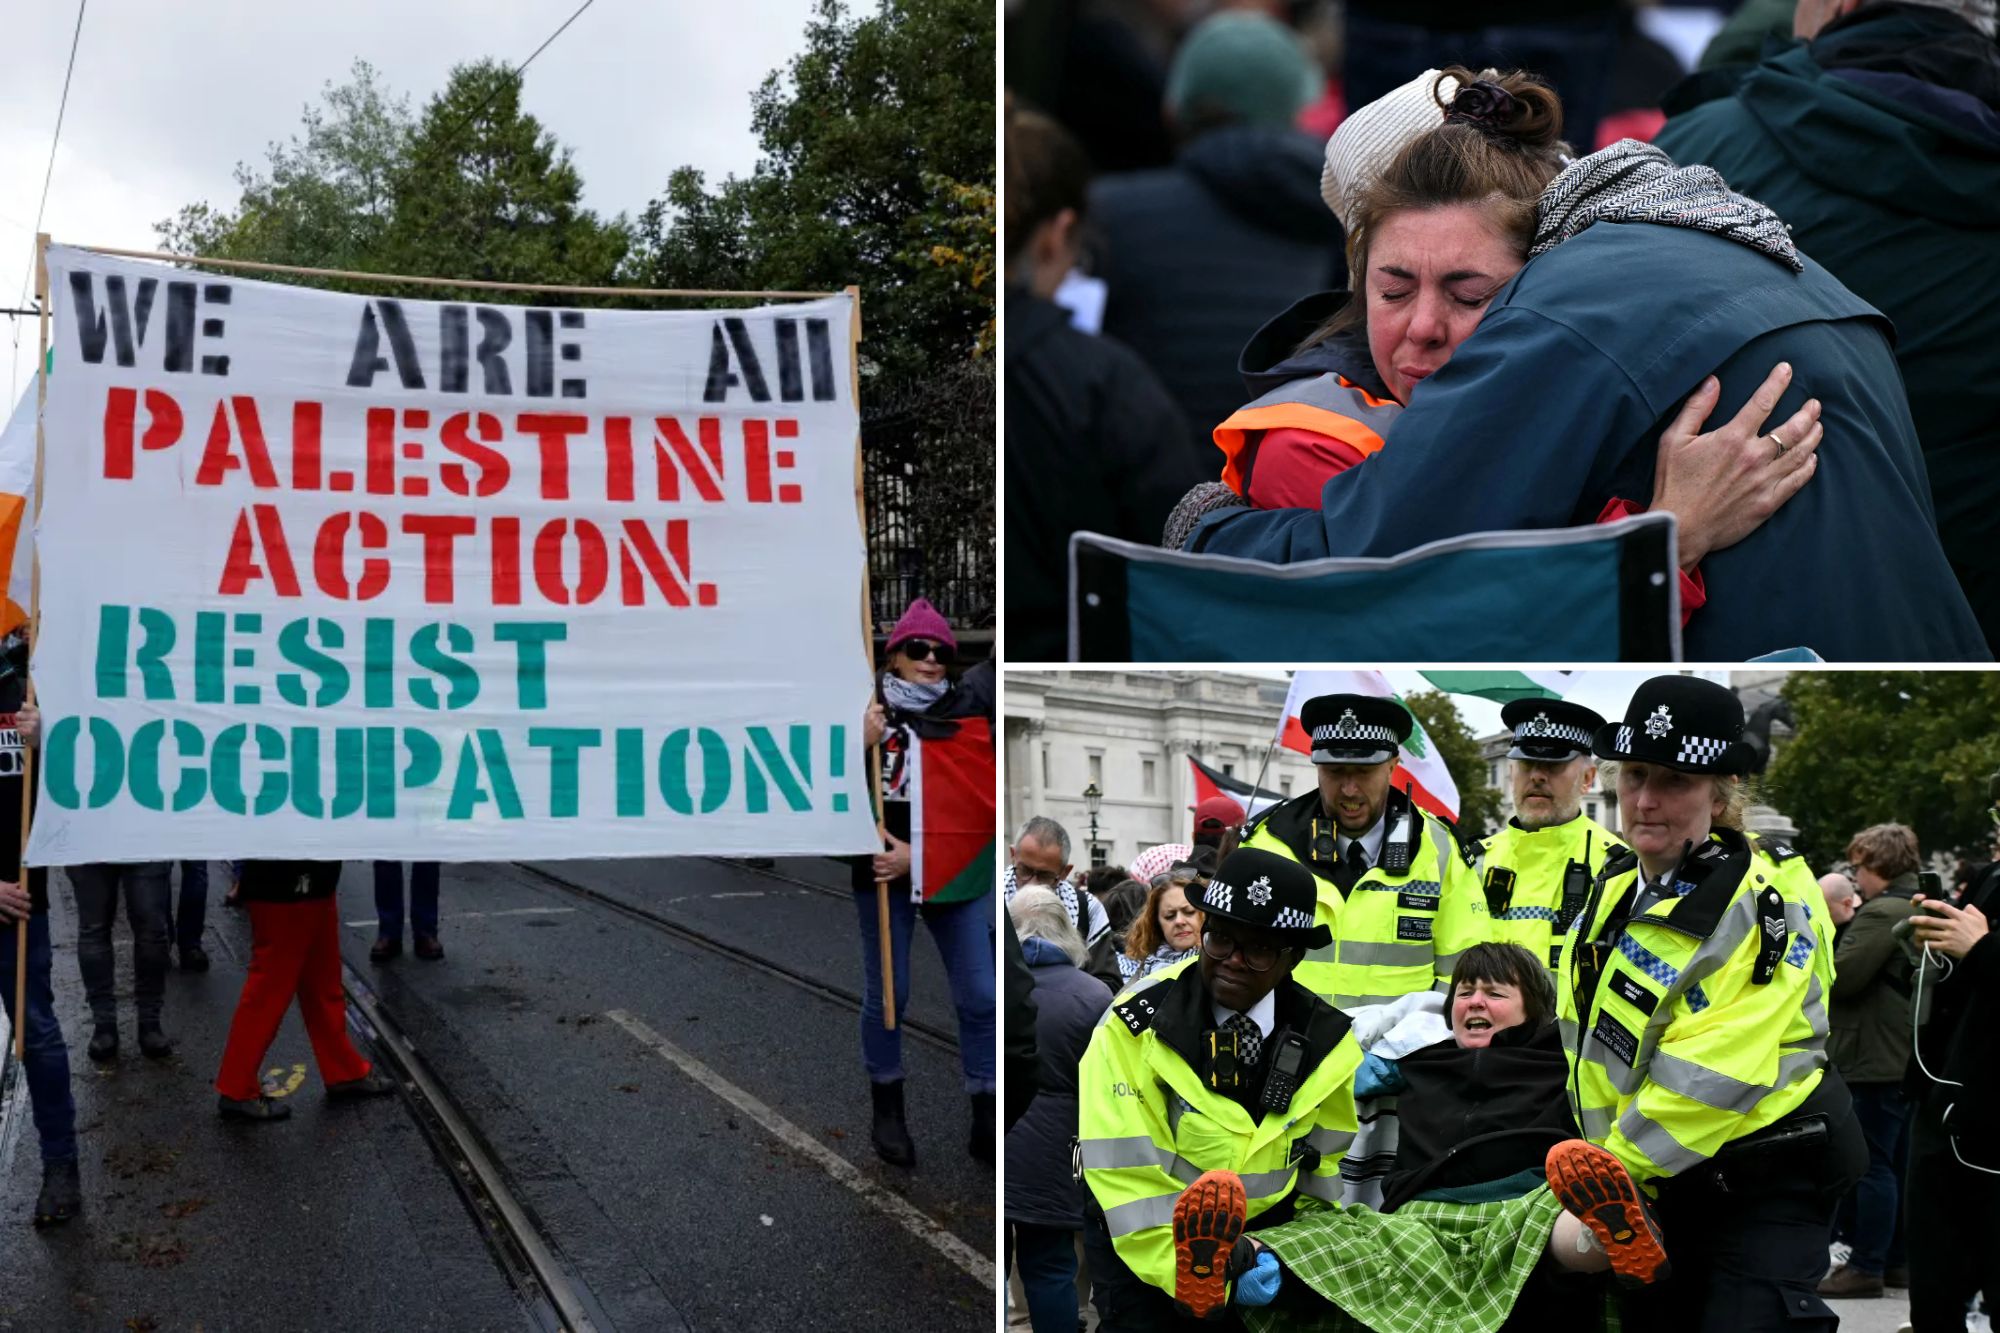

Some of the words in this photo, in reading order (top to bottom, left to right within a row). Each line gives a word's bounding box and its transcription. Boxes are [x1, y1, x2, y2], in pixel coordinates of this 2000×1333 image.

[70, 271, 232, 376] WE
[346, 300, 587, 398] ARE
[103, 387, 803, 503] PALESTINE
[218, 504, 718, 608] ACTION.
[96, 604, 567, 711] RESIST
[44, 715, 849, 820] OCCUPATION!
[1120, 1007, 1140, 1029] 425
[1139, 999, 1155, 1015] CO
